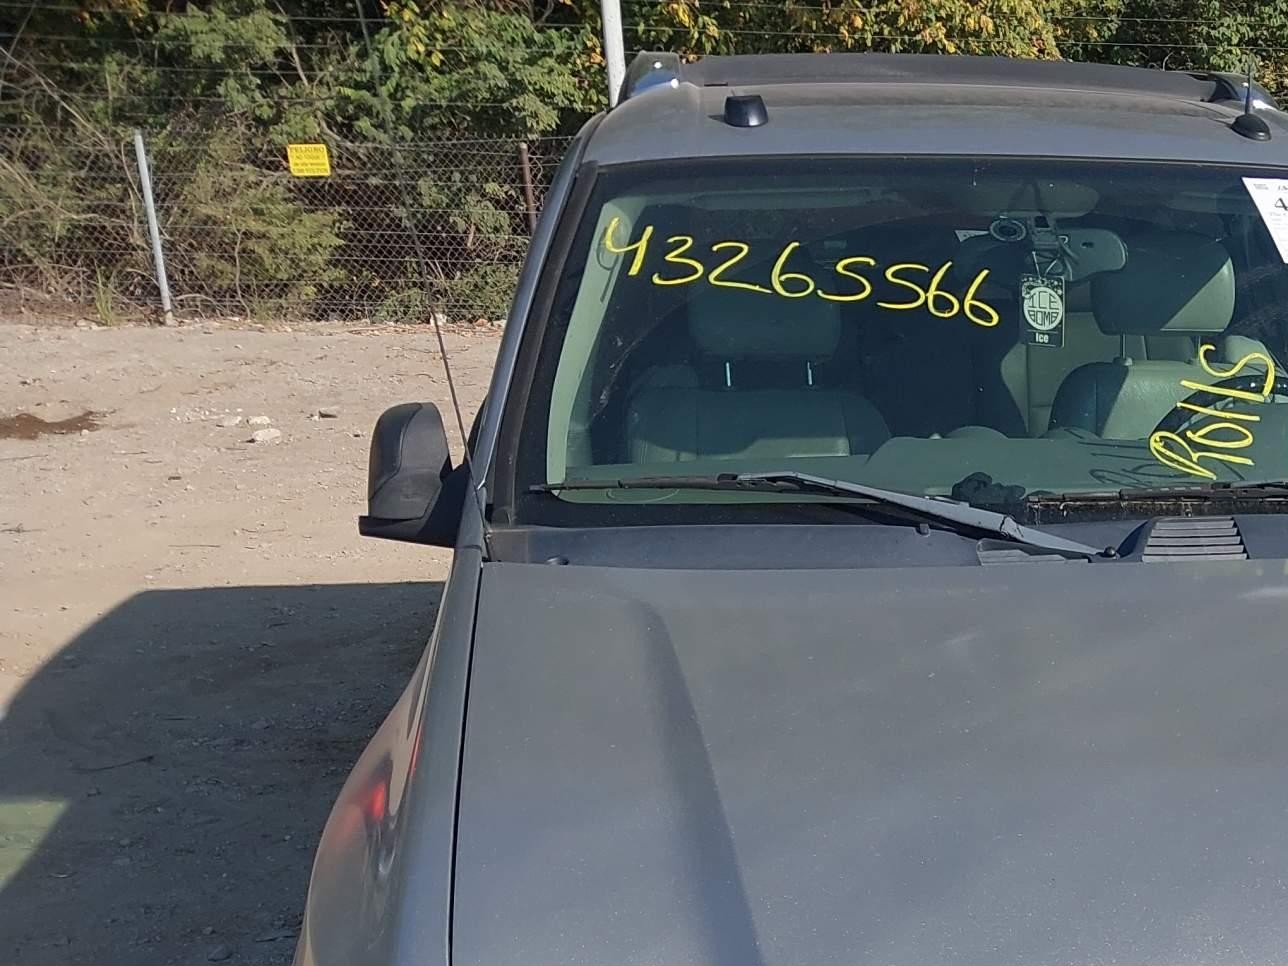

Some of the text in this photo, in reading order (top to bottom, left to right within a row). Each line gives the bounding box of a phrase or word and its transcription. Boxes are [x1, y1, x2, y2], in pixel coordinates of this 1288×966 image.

[605, 217, 1000, 327] 43265566
[1027, 290, 1060, 310] ICE
[1028, 310, 1060, 328] BOMB
[1035, 332, 1049, 344] Ice
